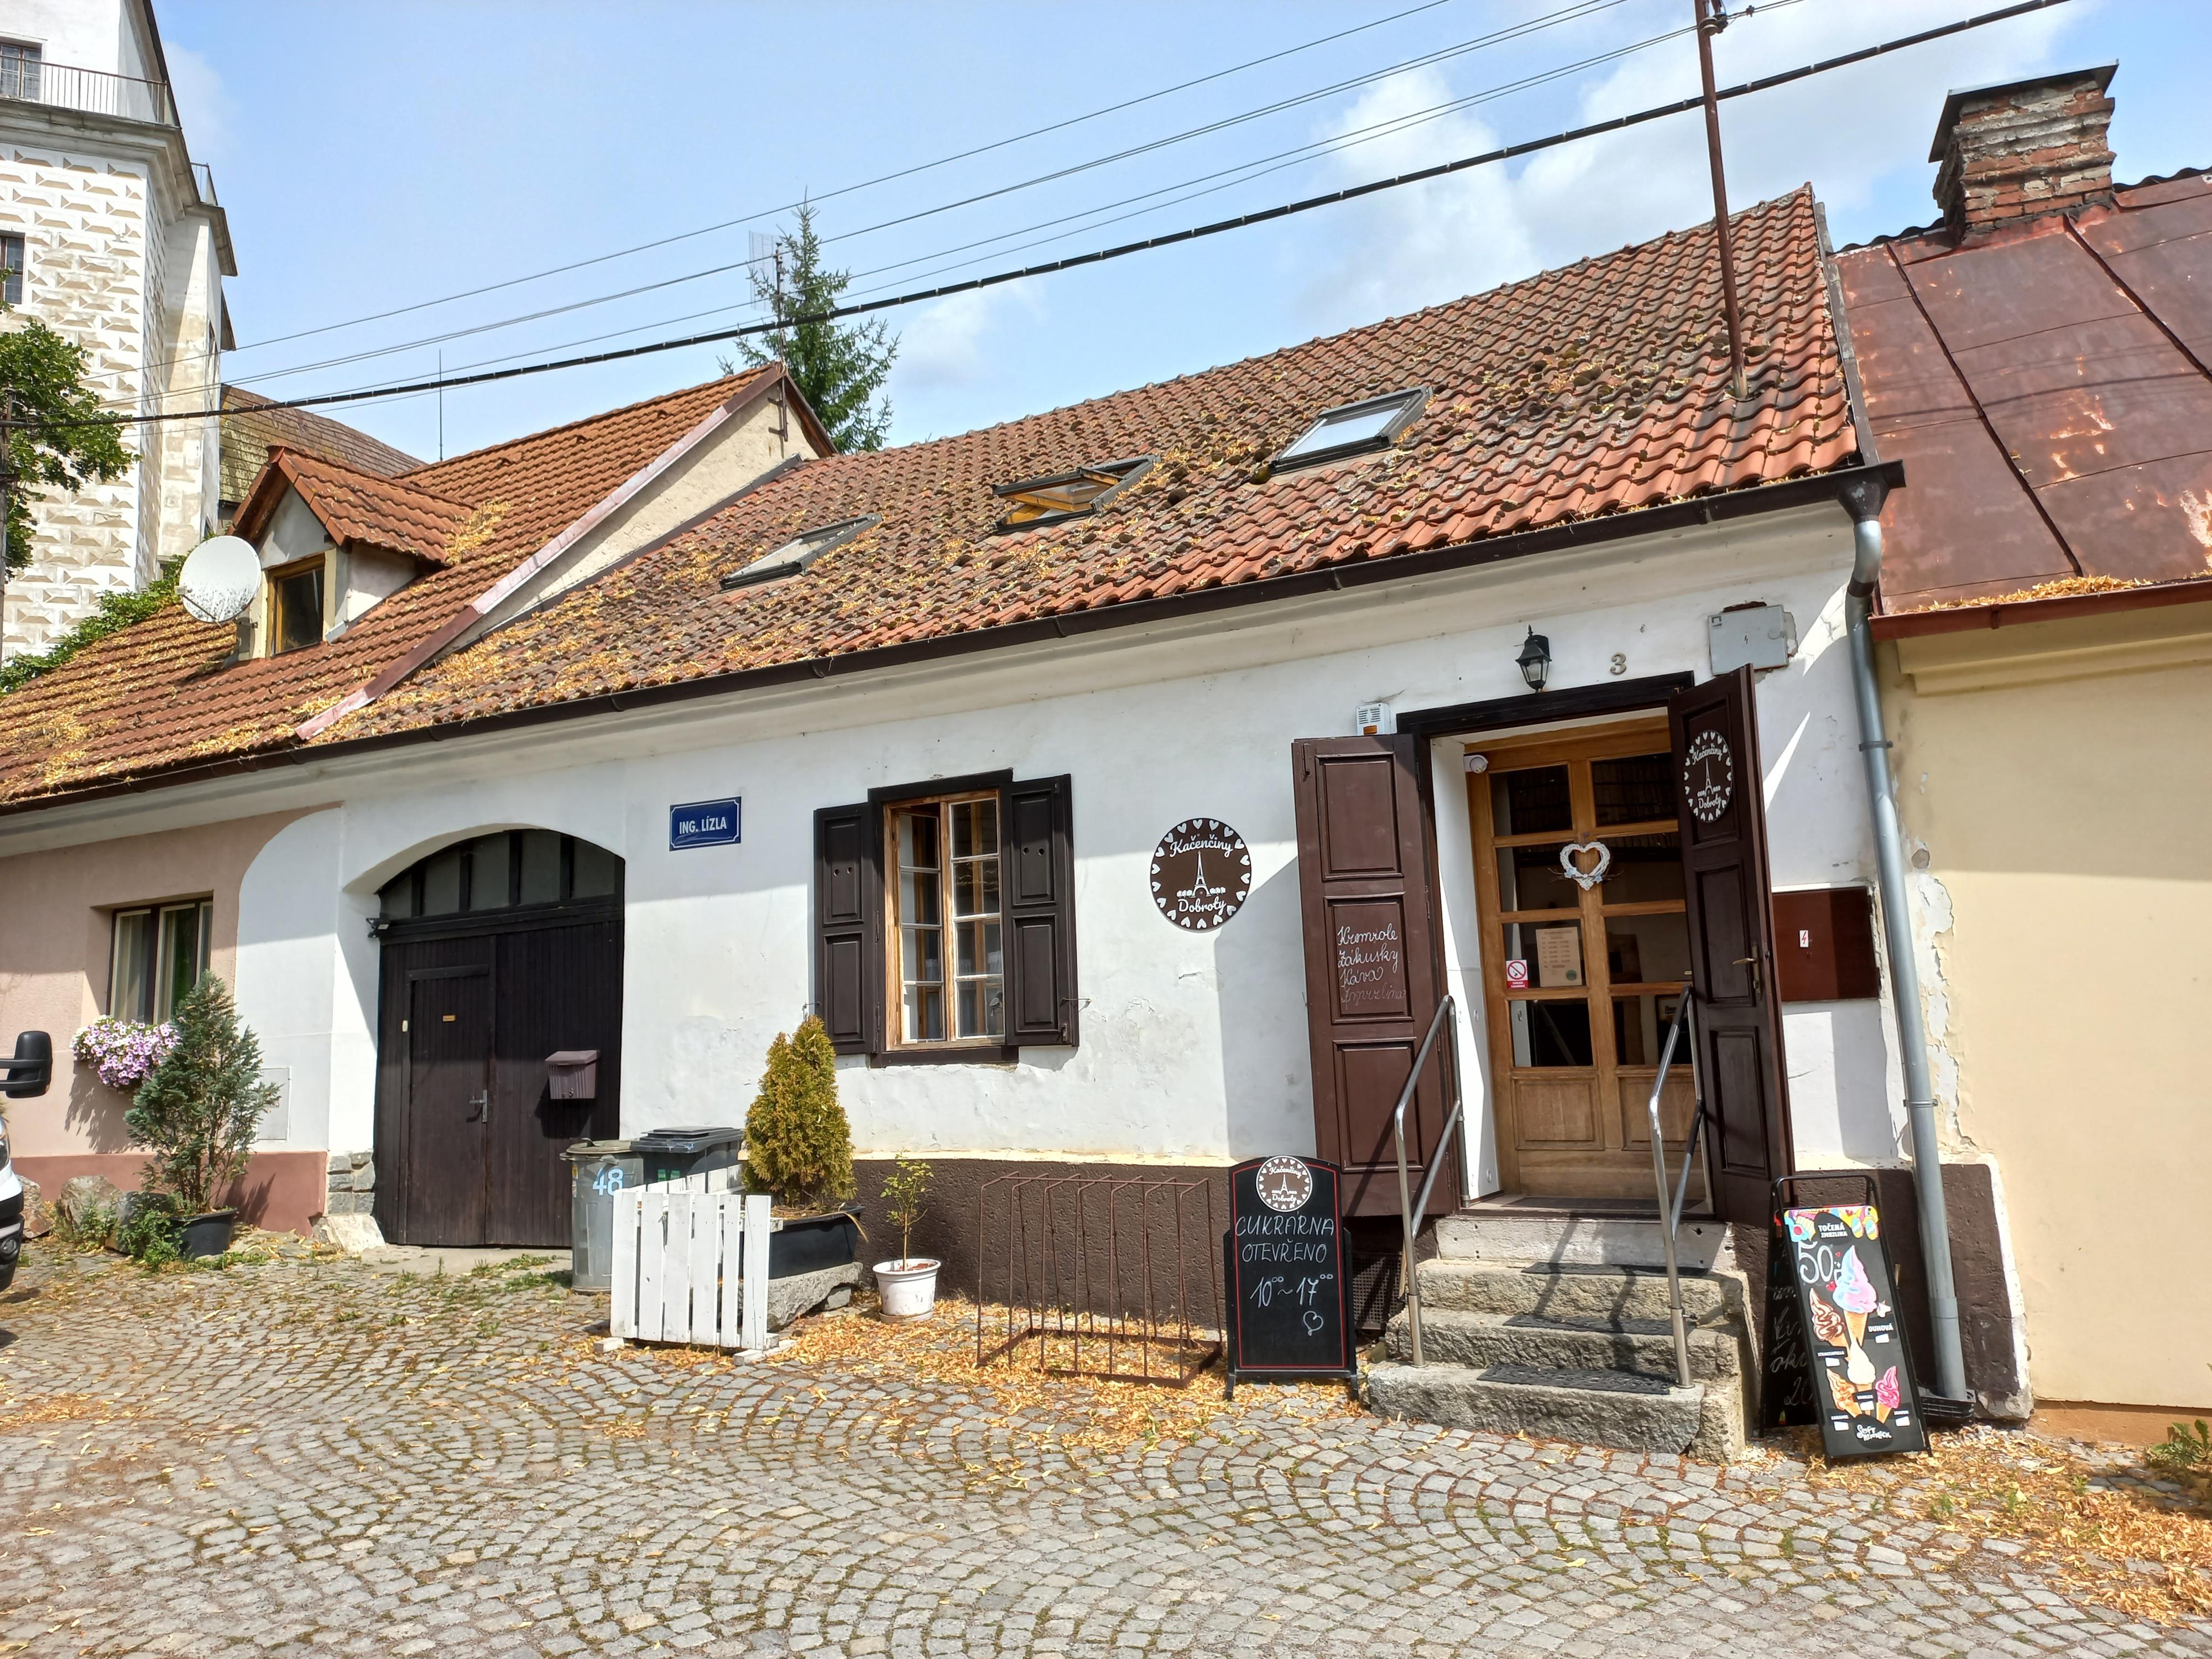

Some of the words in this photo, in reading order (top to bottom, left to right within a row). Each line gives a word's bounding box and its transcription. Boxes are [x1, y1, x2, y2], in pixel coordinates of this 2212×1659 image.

[1610, 653, 1627, 675] 3
[1692, 743, 1723, 766] Kačenčiny
[1698, 794, 1721, 809] Dobroty
[679, 821, 698, 834] ING.
[701, 816, 727, 832] LÍZLA
[1169, 833, 1233, 858] Kačenčiny
[1177, 896, 1227, 915] Dobroty
[1269, 1165, 1302, 1179] Kačenčiny
[592, 1168, 624, 1196] 48
[1272, 1194, 1297, 1204] Dobroty
[1235, 1211, 1334, 1237] CUKRÁRNA
[1818, 1222, 1845, 1232] TOČENÁ
[1242, 1238, 1327, 1263] OTEVŘENO
[1867, 1323, 1893, 1332] DUHOVÁ
